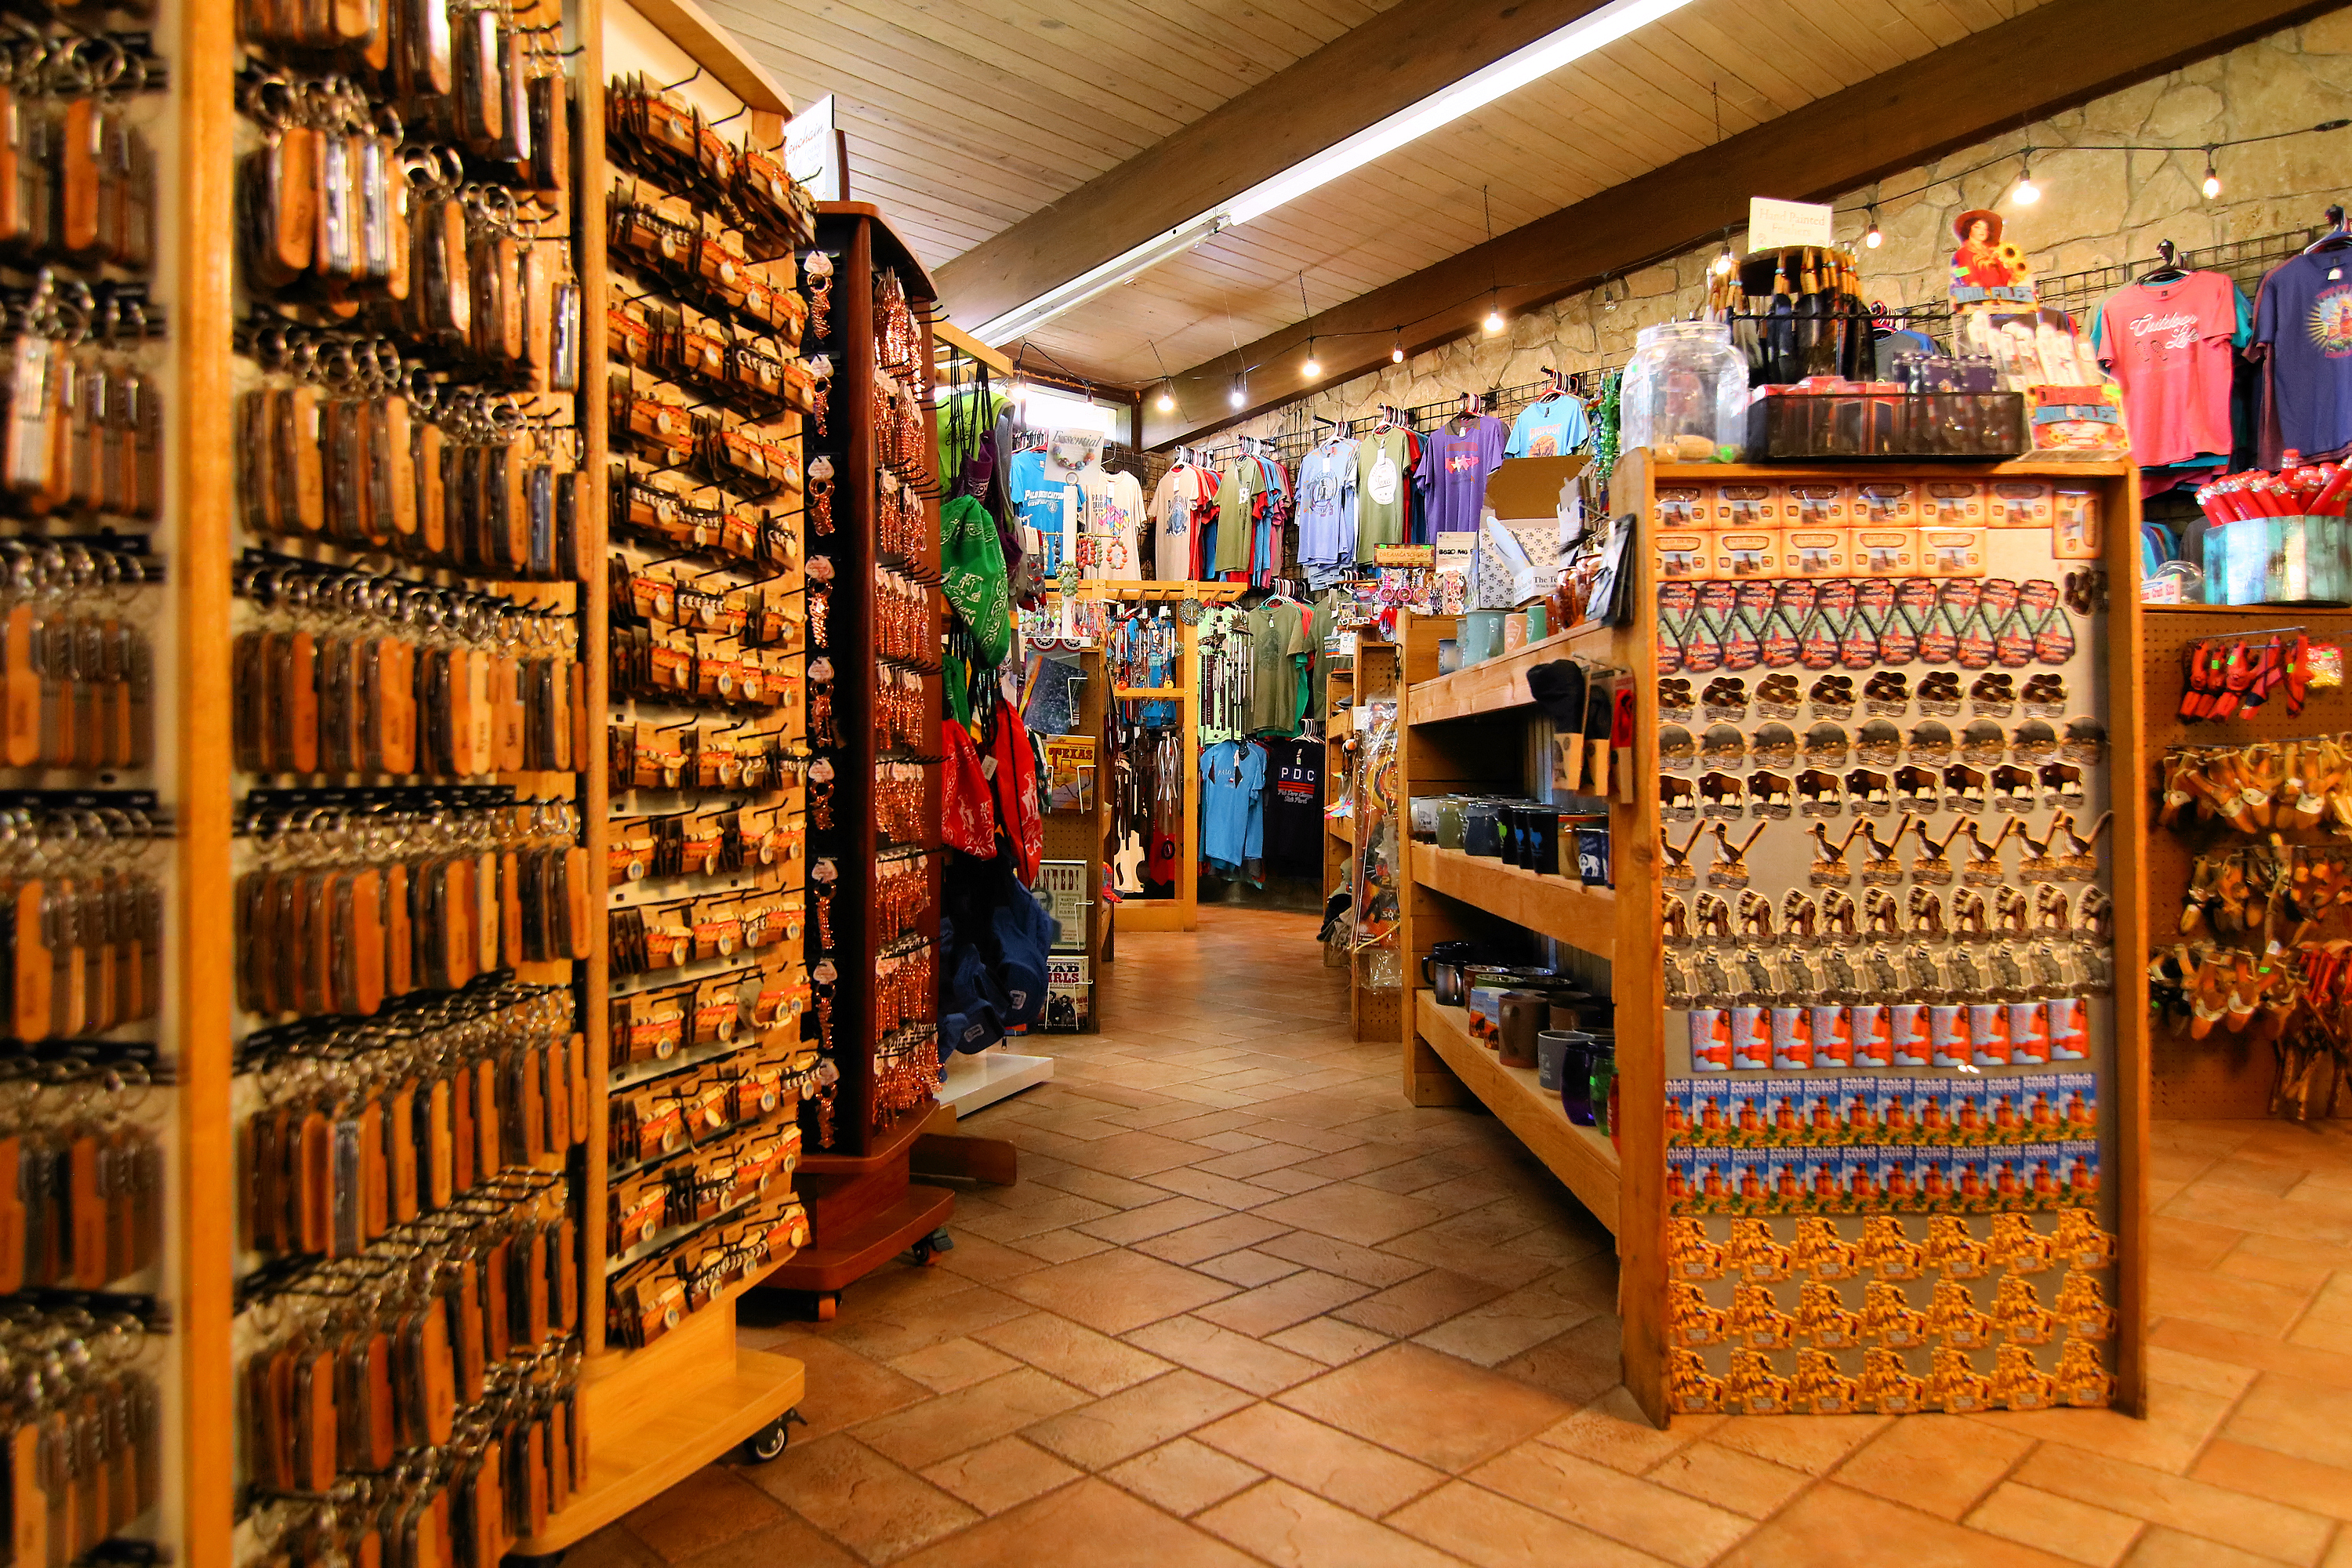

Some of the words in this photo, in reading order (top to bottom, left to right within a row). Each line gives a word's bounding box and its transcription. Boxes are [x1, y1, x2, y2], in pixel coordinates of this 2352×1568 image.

[1759, 209, 1786, 221] Hand
[1789, 212, 1825, 226] Painted
[1051, 430, 1102, 448] Essential
[1529, 423, 1562, 441] BIGFOOT
[1048, 747, 1093, 769] TEXAS
[1035, 869, 1080, 891] ANTED!
[1047, 973, 1080, 983] IRLS
